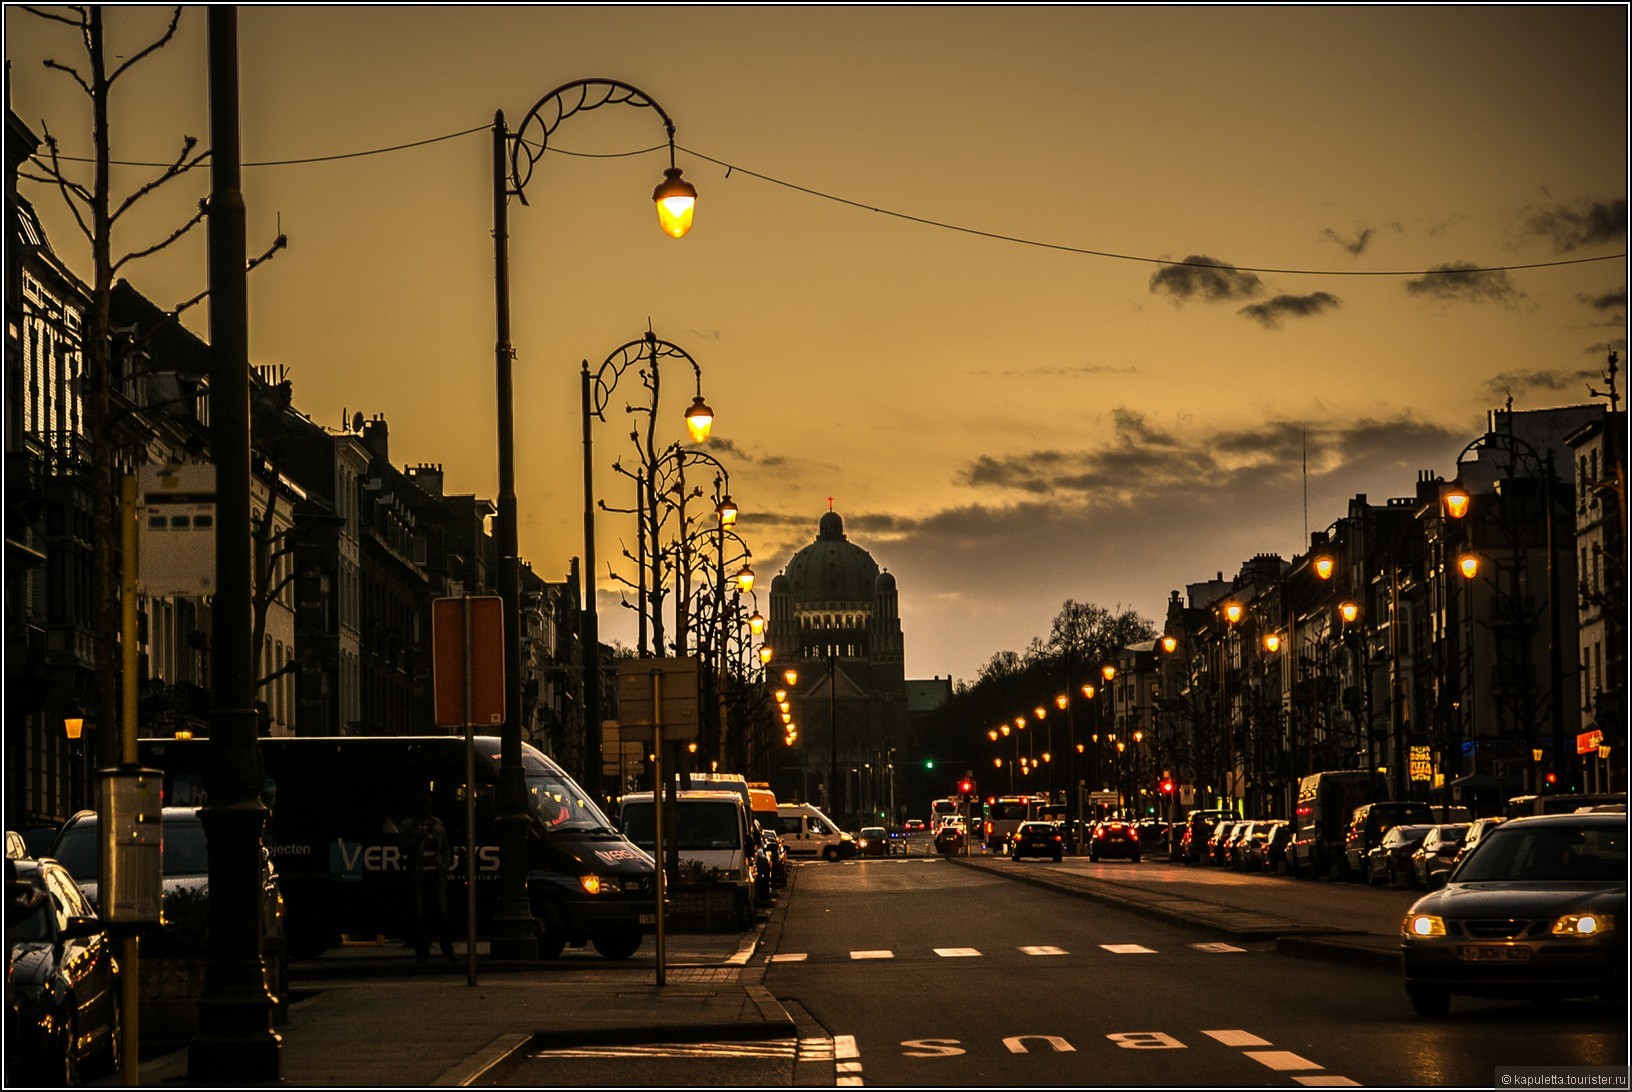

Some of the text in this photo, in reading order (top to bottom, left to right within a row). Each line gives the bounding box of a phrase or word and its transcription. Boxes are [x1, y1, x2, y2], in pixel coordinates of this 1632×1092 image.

[1410, 761, 1431, 770] PIZZA
[266, 842, 311, 857] ojecten
[900, 1031, 1189, 1058] BUS
